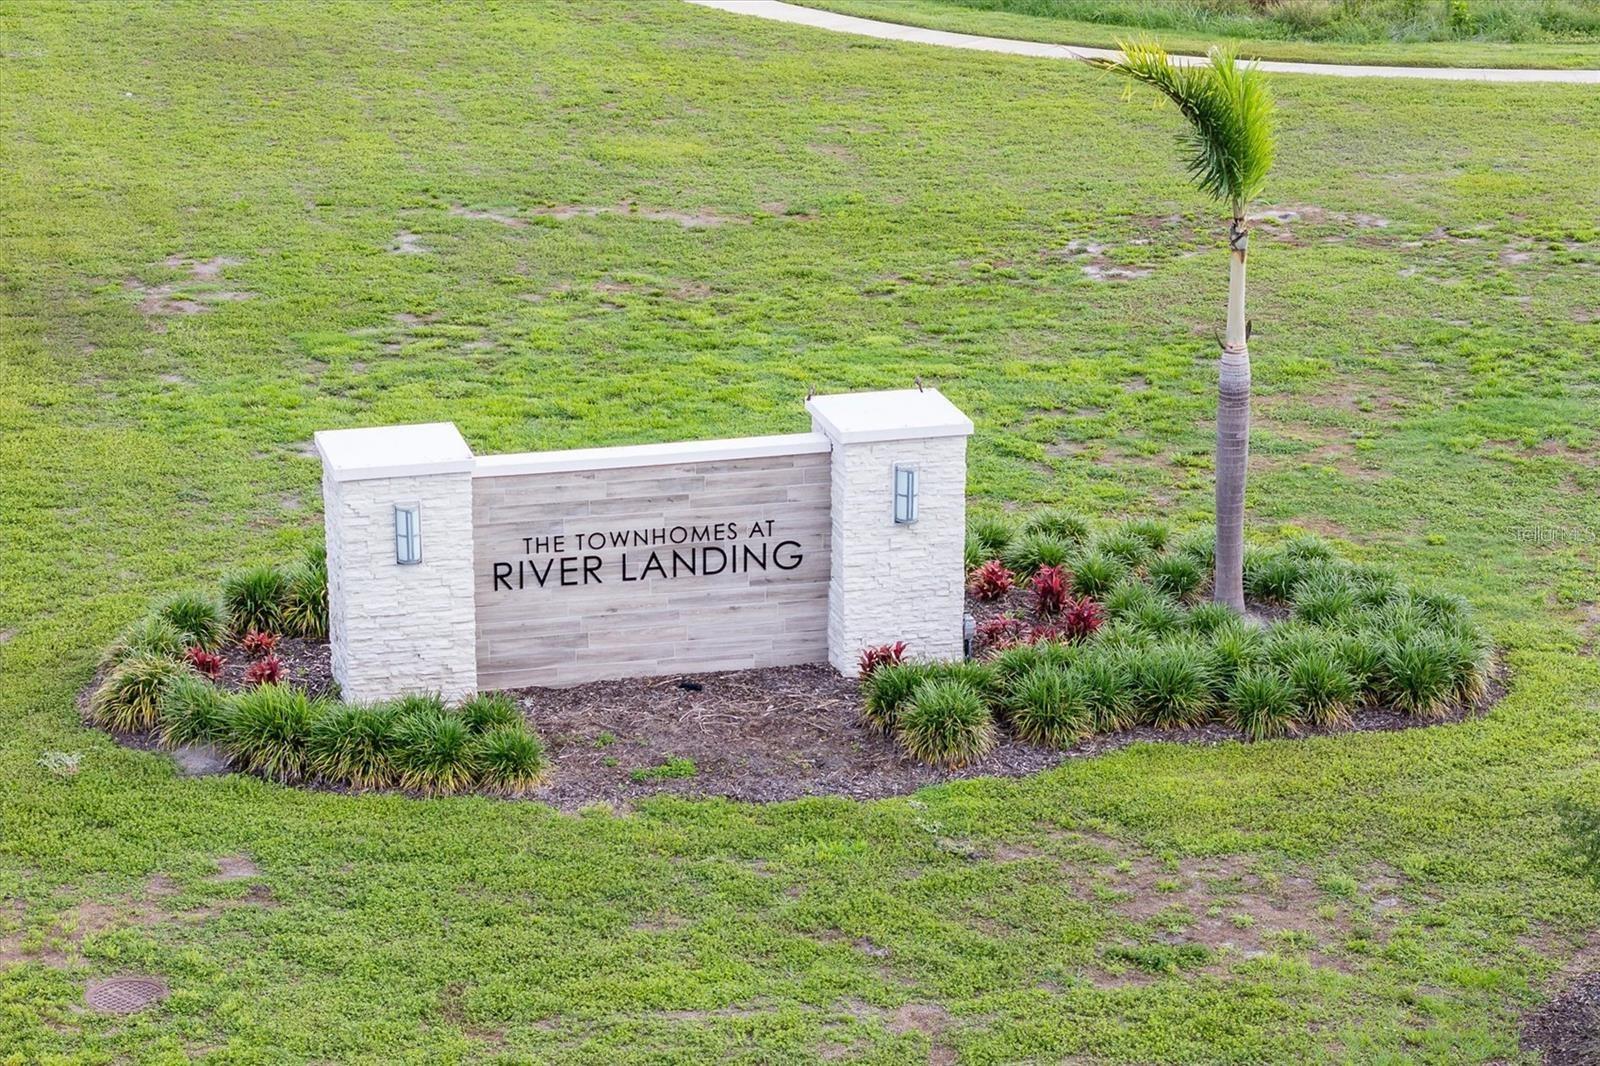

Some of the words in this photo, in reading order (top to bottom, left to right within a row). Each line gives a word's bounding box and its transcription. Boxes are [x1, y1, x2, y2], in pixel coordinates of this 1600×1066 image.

[522, 535, 566, 555] THE
[575, 522, 738, 552] TOWNHOMES
[748, 519, 776, 540] AT
[493, 556, 604, 592] RIVER
[622, 540, 804, 582] LANDING
